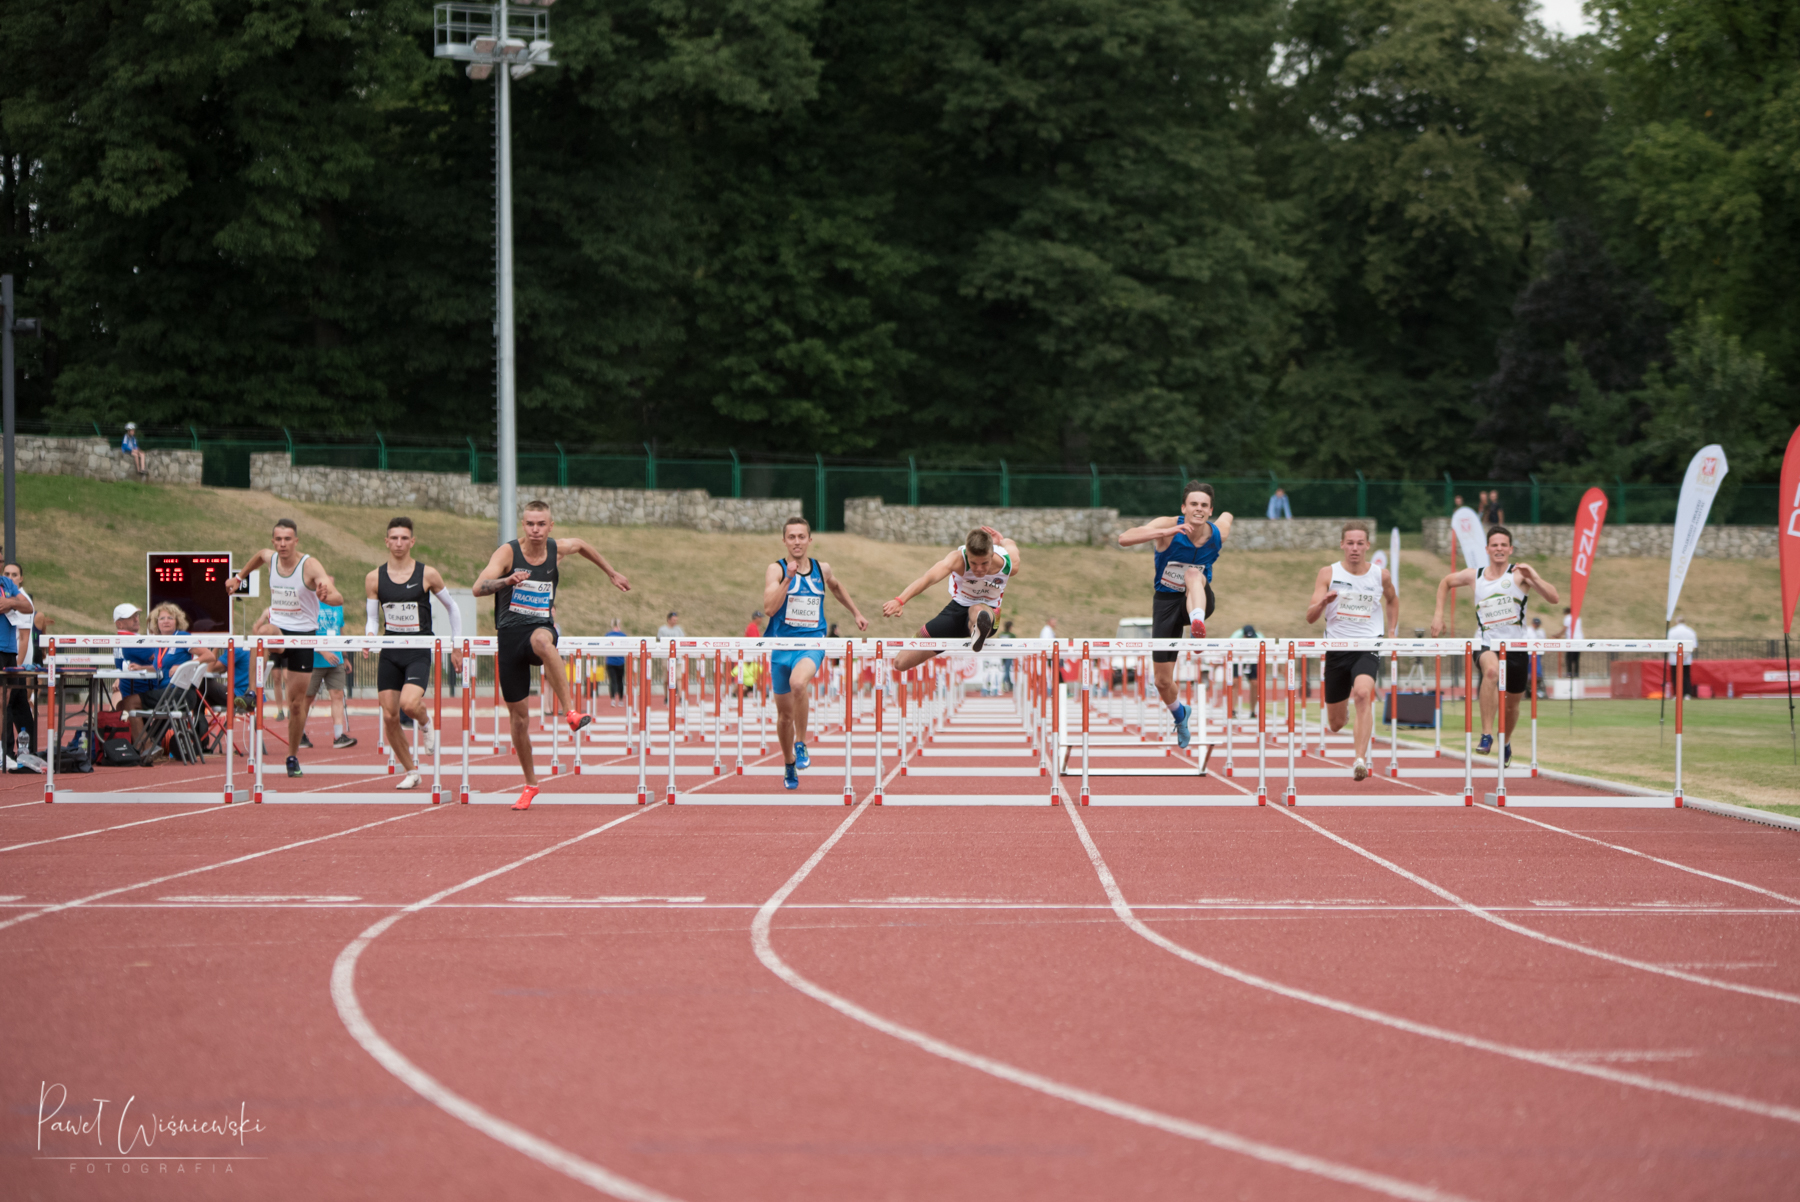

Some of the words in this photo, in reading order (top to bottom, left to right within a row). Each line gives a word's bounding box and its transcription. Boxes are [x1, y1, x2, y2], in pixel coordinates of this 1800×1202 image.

[1575, 500, 1603, 576] PZLA
[538, 583, 552, 592] 672
[284, 590, 297, 598] 571
[1359, 594, 1373, 602] 193
[1497, 596, 1512, 605] 212
[1339, 603, 1371, 612] JANOWSKI
[388, 613, 415, 621] DEJNEKO
[791, 608, 816, 617] MIRECKI
[1484, 608, 1513, 618] WŁOSTEK
